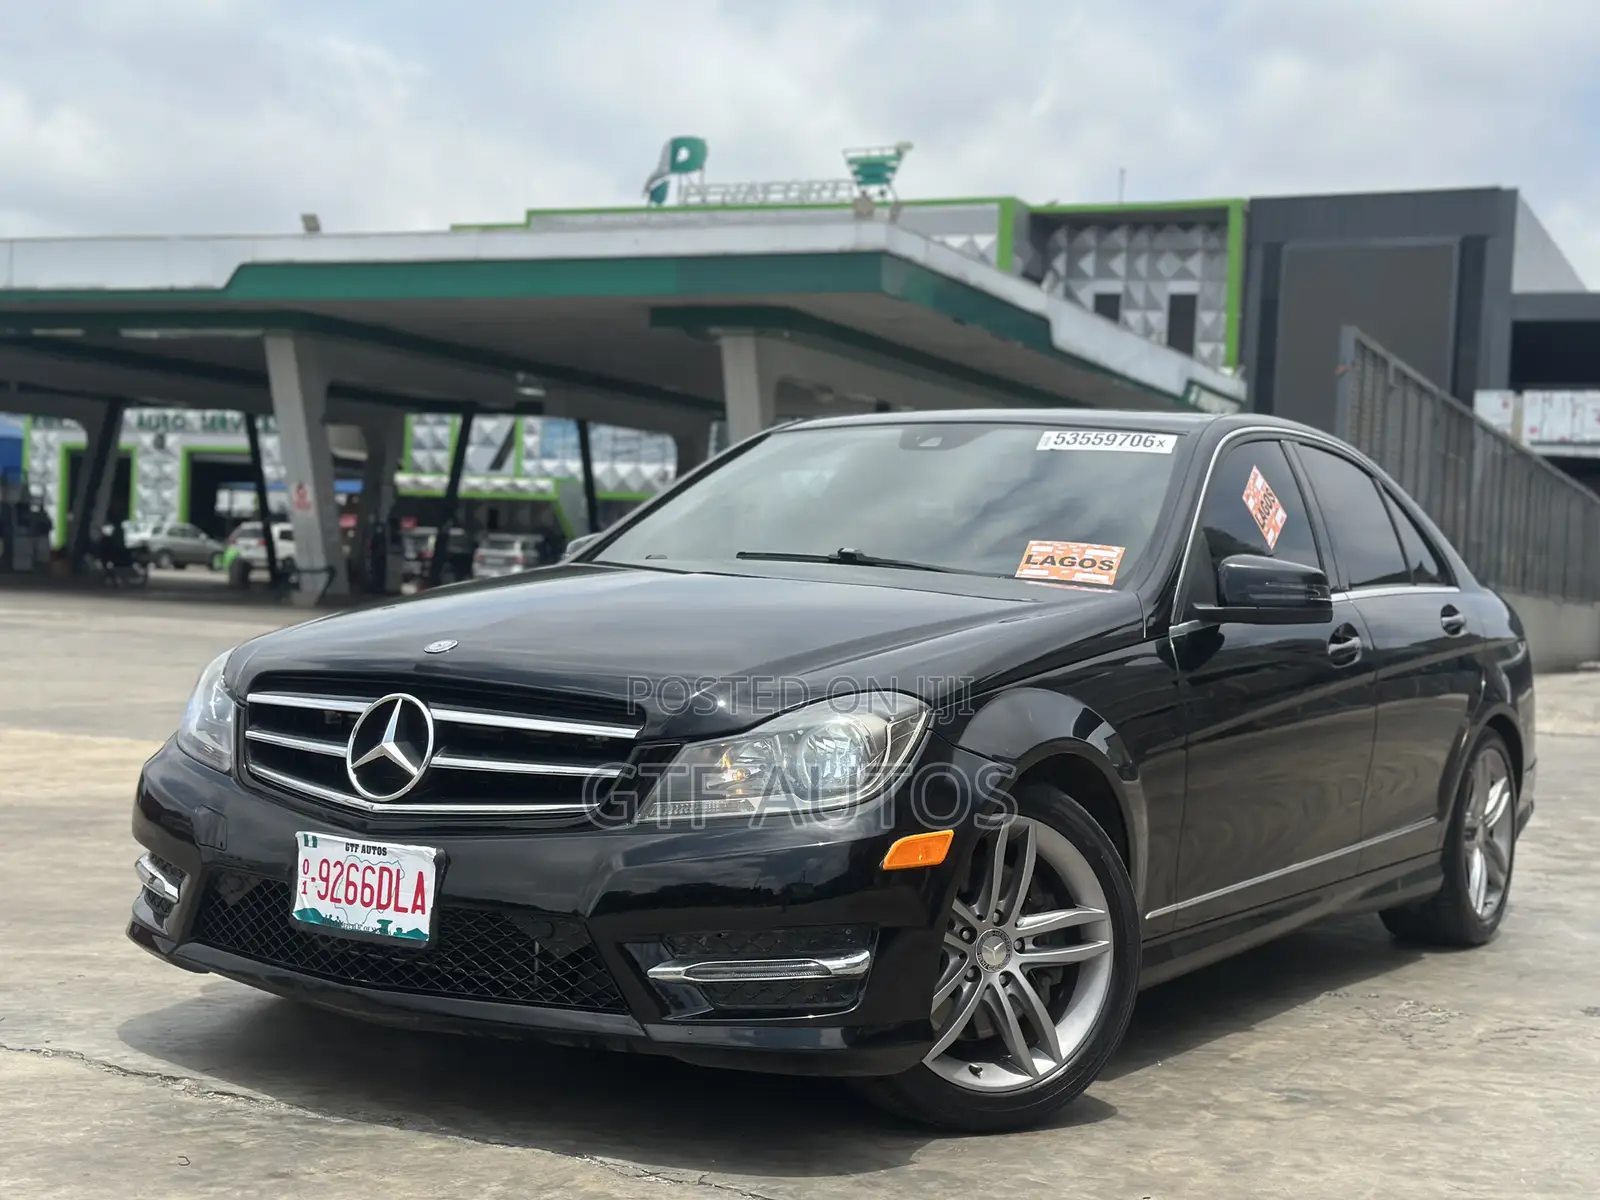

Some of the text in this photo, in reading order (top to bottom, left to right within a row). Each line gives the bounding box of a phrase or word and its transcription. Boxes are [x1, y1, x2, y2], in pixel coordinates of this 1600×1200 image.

[1254, 487, 1276, 530] LAGOS
[1024, 554, 1115, 571] LAGOS
[345, 843, 388, 857] GTF AUTOS
